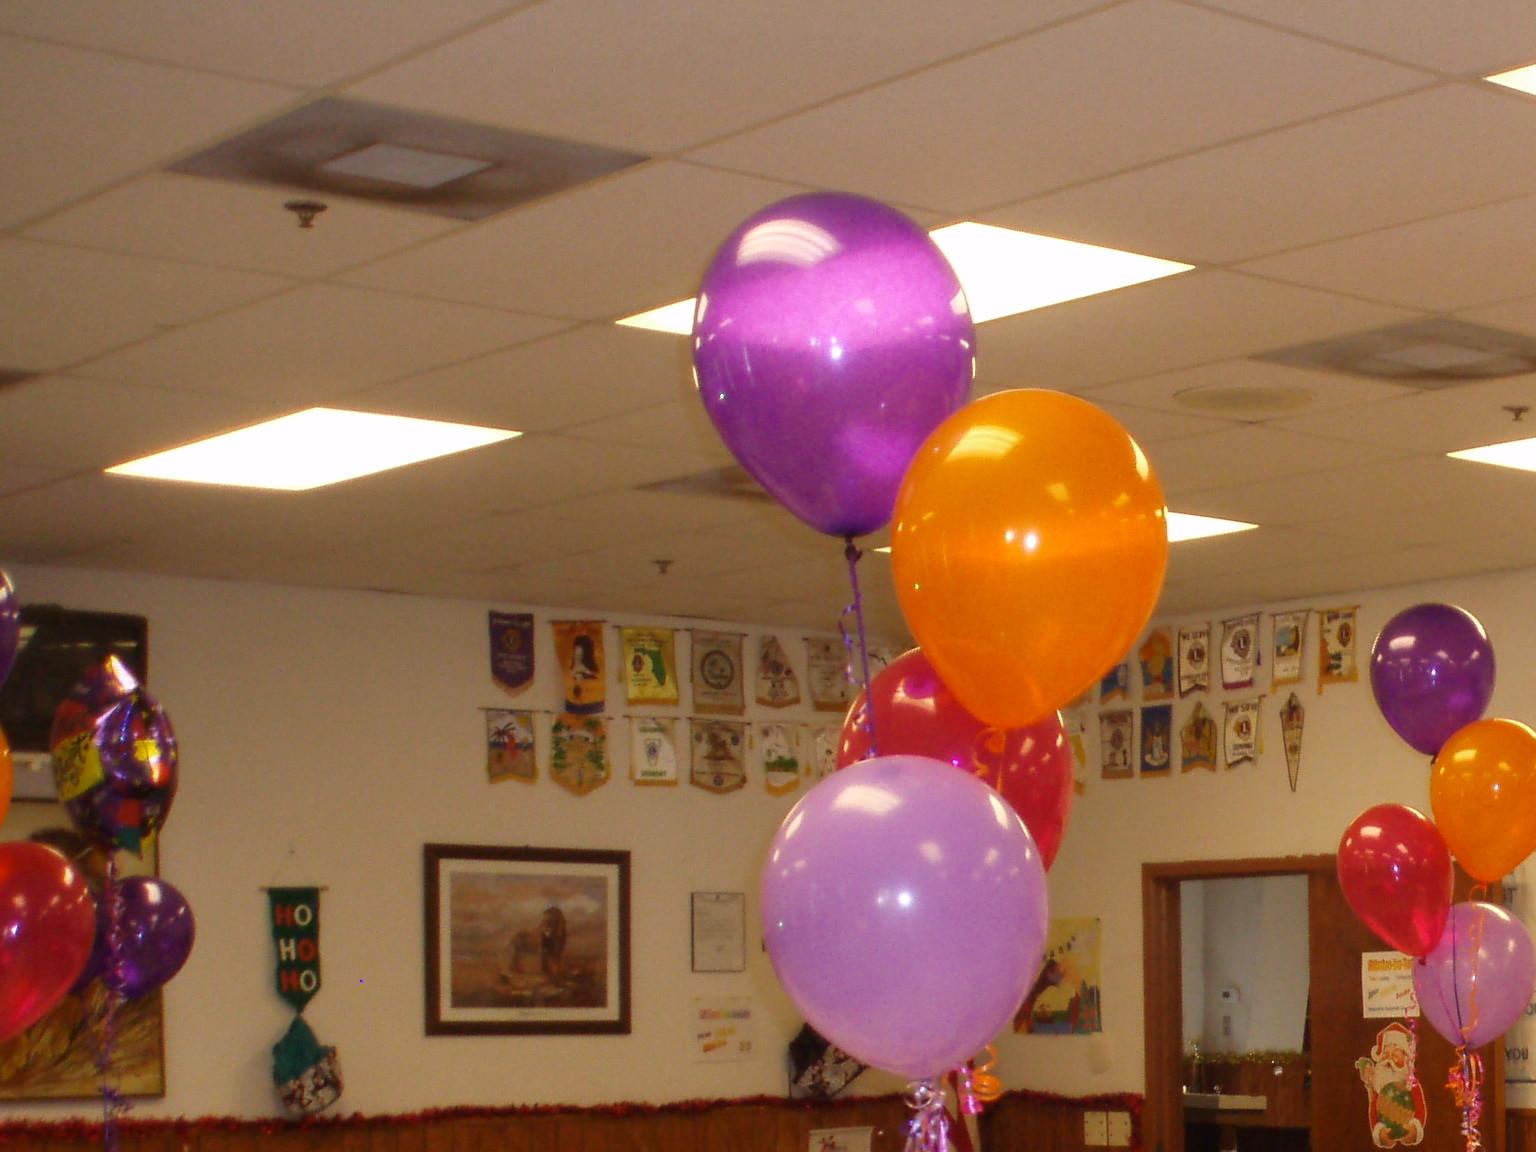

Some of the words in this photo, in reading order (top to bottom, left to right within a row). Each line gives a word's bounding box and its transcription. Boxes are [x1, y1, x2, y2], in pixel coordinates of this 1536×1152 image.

[274, 903, 313, 927] HO
[279, 937, 317, 962] HO
[281, 969, 317, 993] HO
